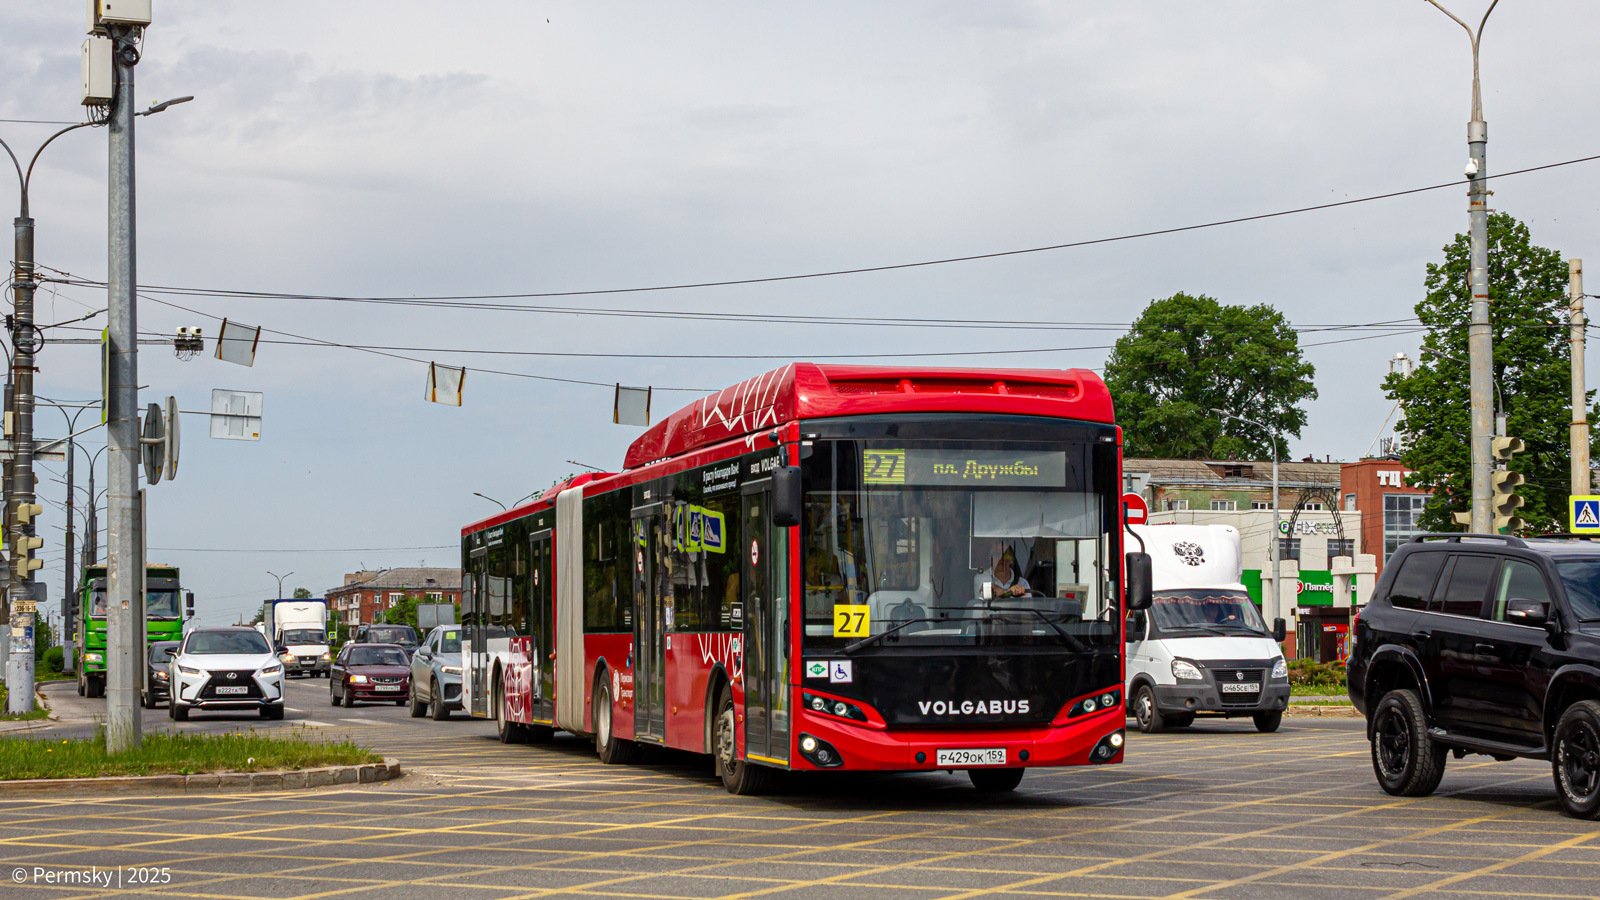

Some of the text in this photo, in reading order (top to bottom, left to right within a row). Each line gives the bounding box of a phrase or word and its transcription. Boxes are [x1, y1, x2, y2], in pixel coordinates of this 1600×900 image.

[868, 454, 899, 479] 27
[933, 460, 1039, 479] пл. Дружбы
[1377, 470, 1401, 488] ТЦ
[838, 612, 866, 634] 27
[918, 700, 1030, 715] VOLGABUS
[940, 750, 1003, 764] Р429ОК 159
